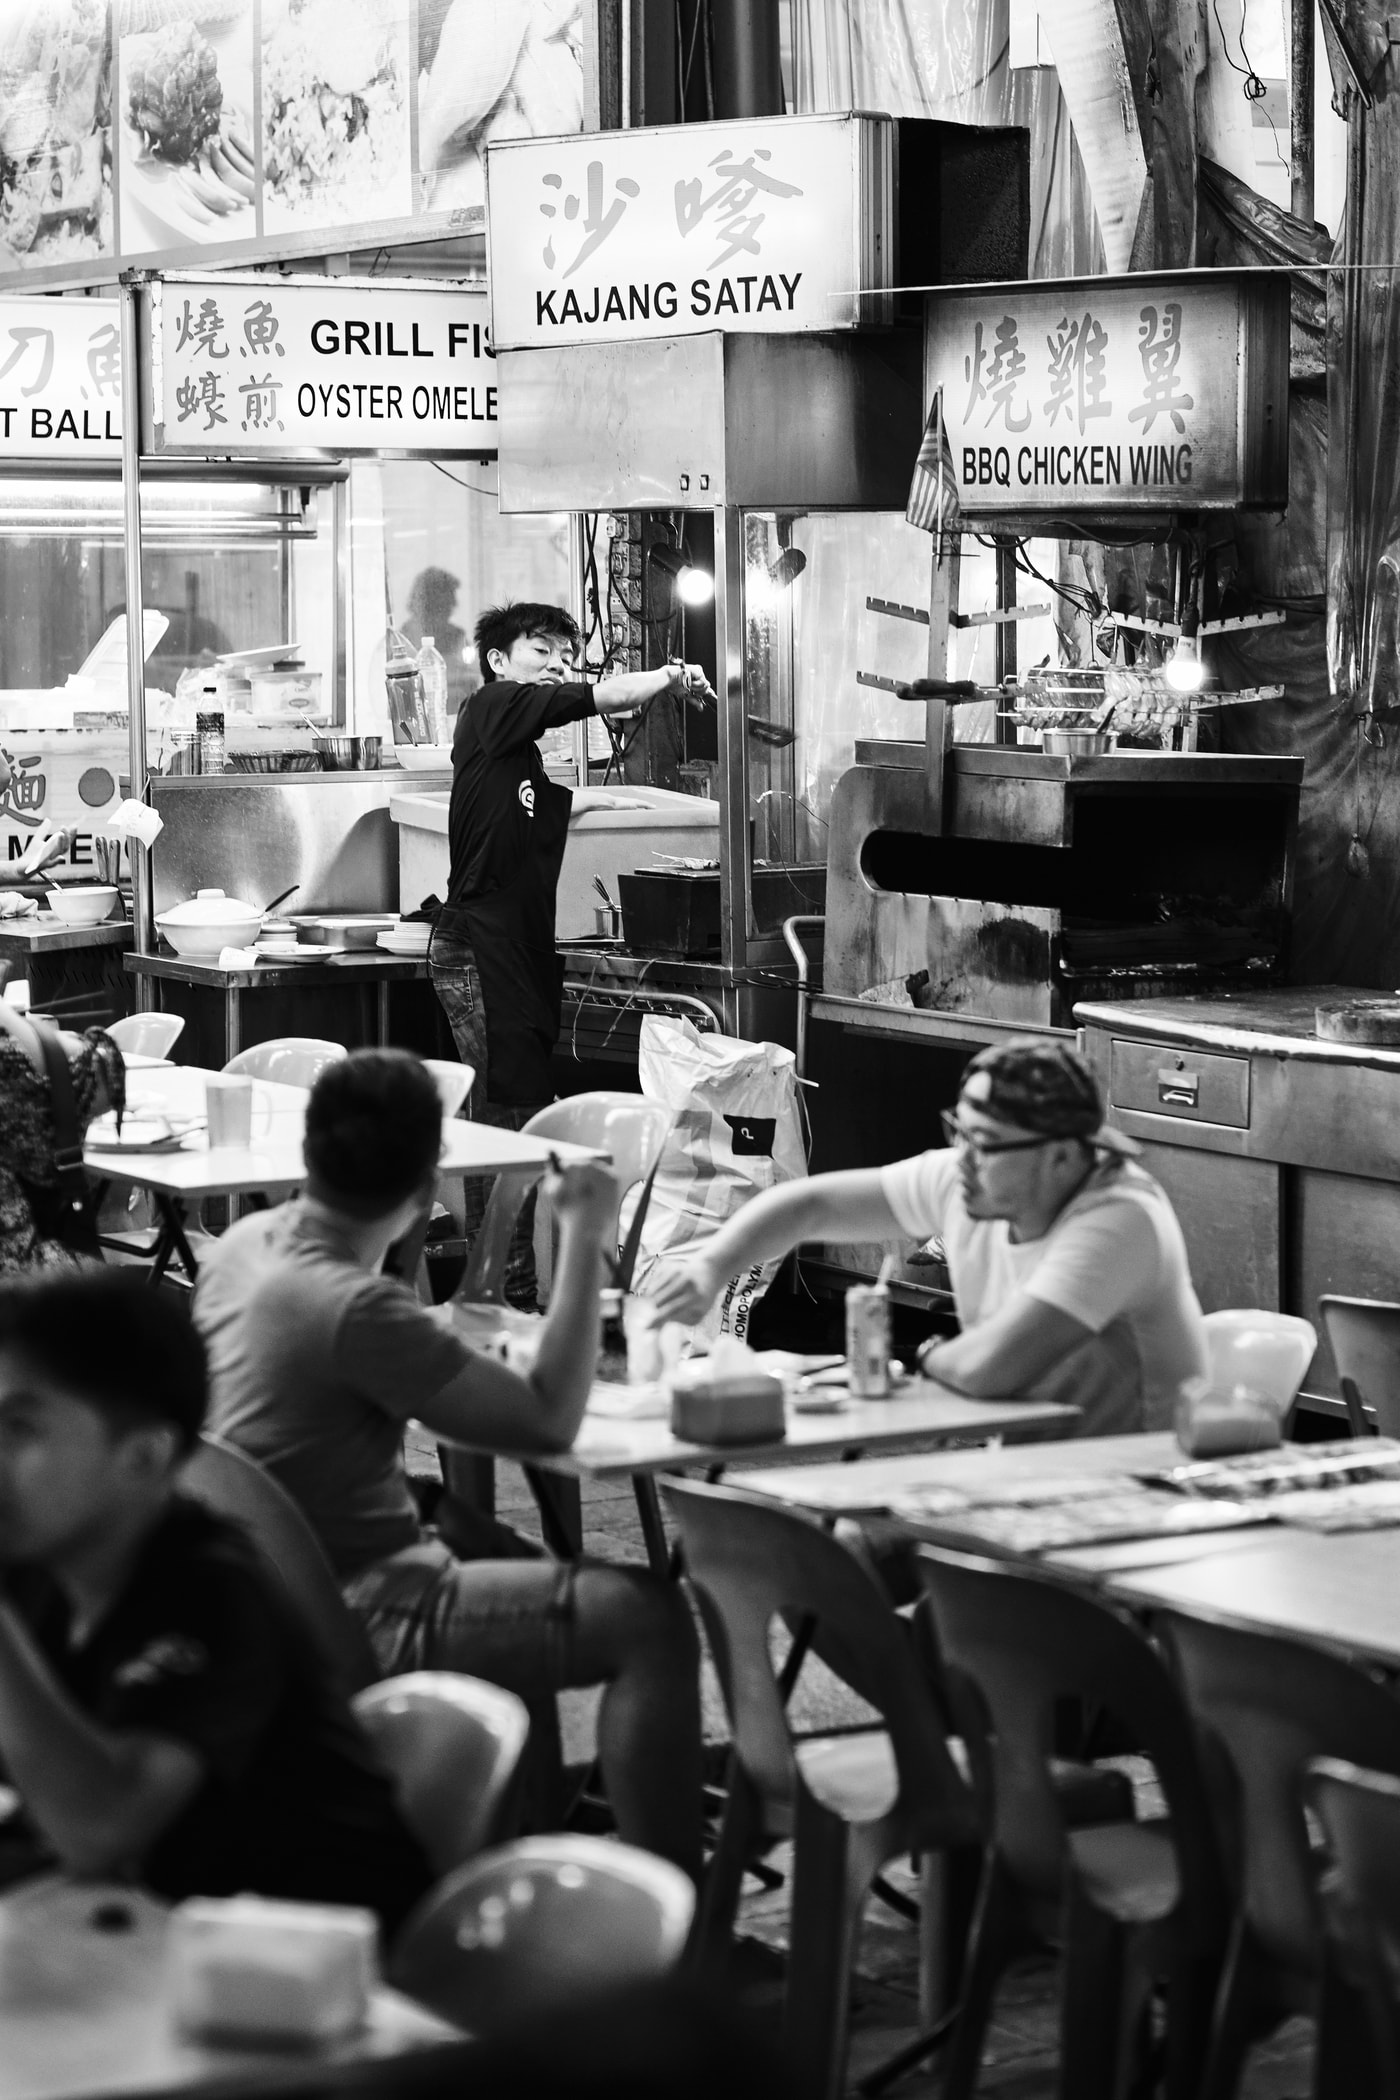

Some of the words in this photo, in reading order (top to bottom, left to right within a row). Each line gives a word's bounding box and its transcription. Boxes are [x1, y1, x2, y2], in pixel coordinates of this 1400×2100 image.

[539, 149, 804, 280] 沙嗲
[536, 281, 678, 326] KAJANG
[690, 272, 803, 316] SATAY
[175, 298, 286, 359] 燒魚
[310, 320, 434, 358] GRILL
[962, 303, 1195, 437] 燒雞翼
[31, 408, 122, 440] BALL
[176, 371, 285, 432] 蠔煎
[297, 382, 402, 420] OYSTER
[412, 385, 498, 421] OMELE
[962, 446, 1011, 488] BBQ
[1017, 445, 1121, 486] CHICKEN
[1129, 443, 1193, 486] WING
